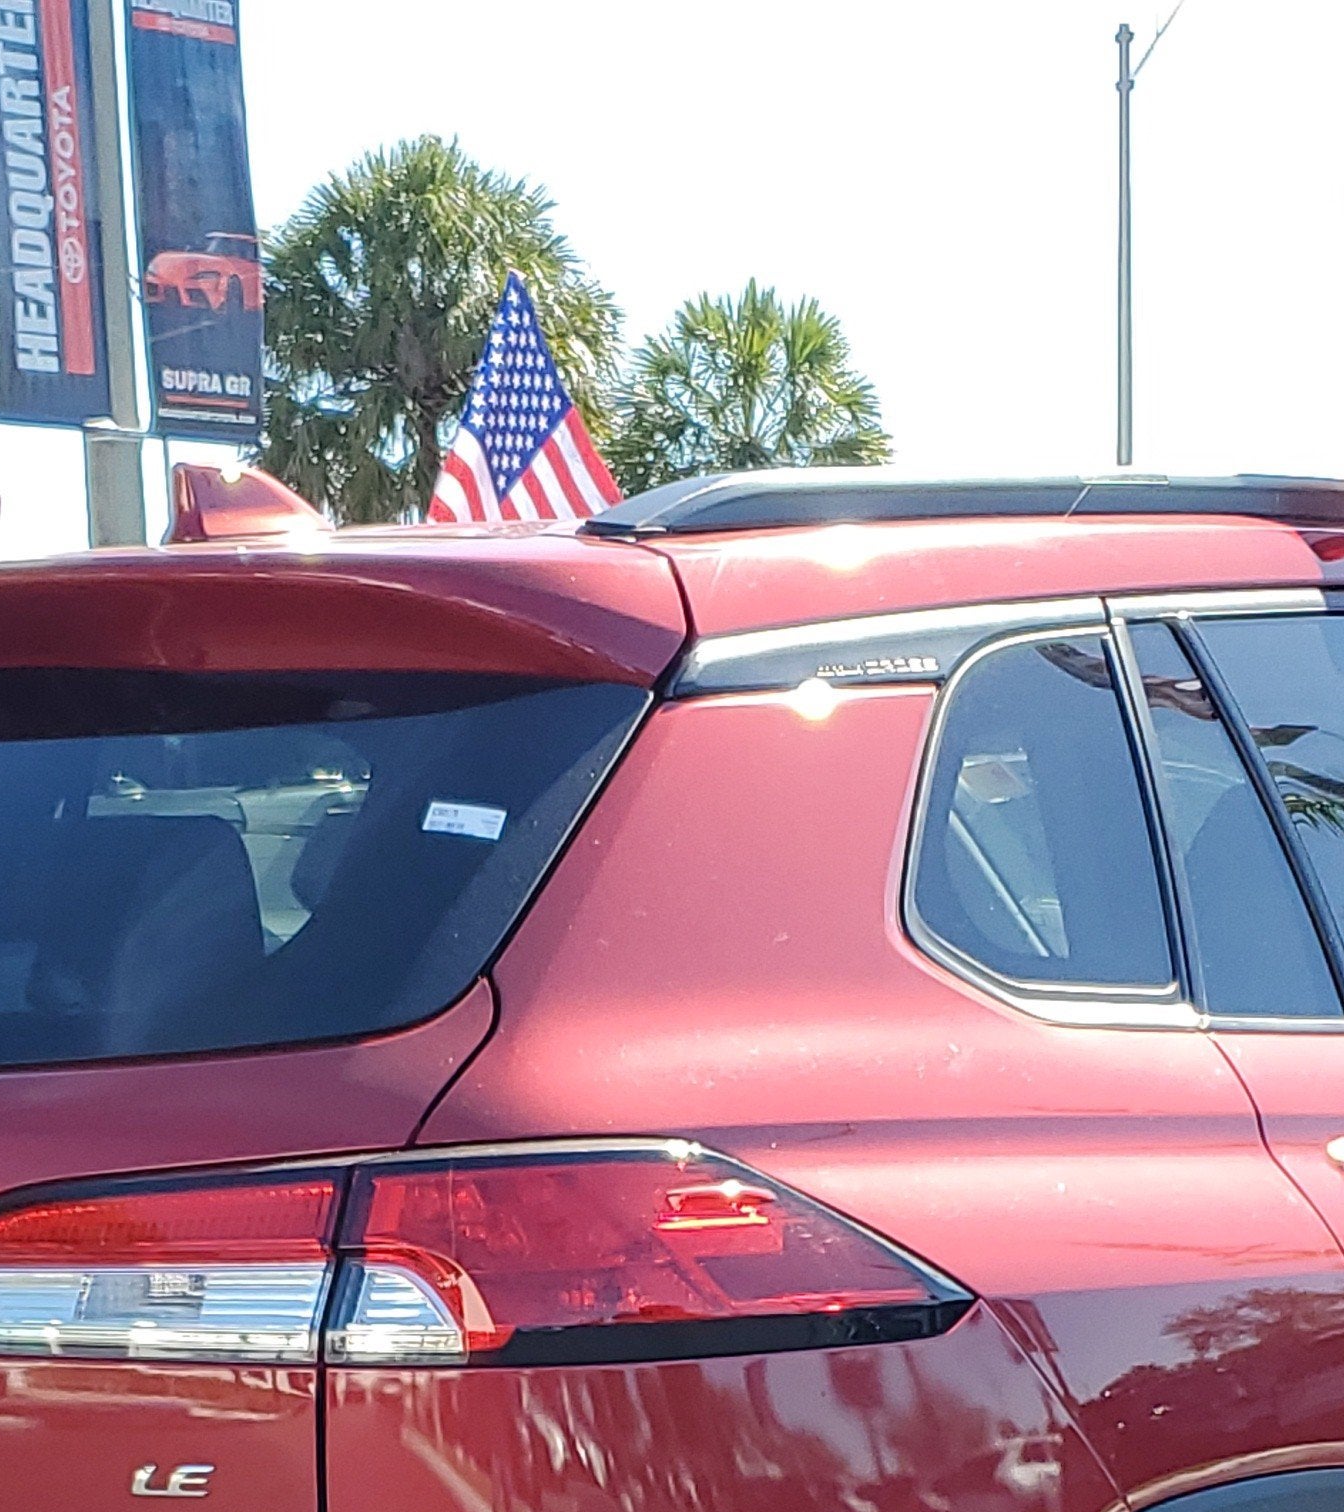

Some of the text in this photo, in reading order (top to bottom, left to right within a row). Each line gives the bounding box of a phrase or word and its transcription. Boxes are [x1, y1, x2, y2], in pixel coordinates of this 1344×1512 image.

[52, 85, 81, 232] TOYOTA
[161, 367, 251, 397] SUPRA GR
[131, 1464, 215, 1498] LE
